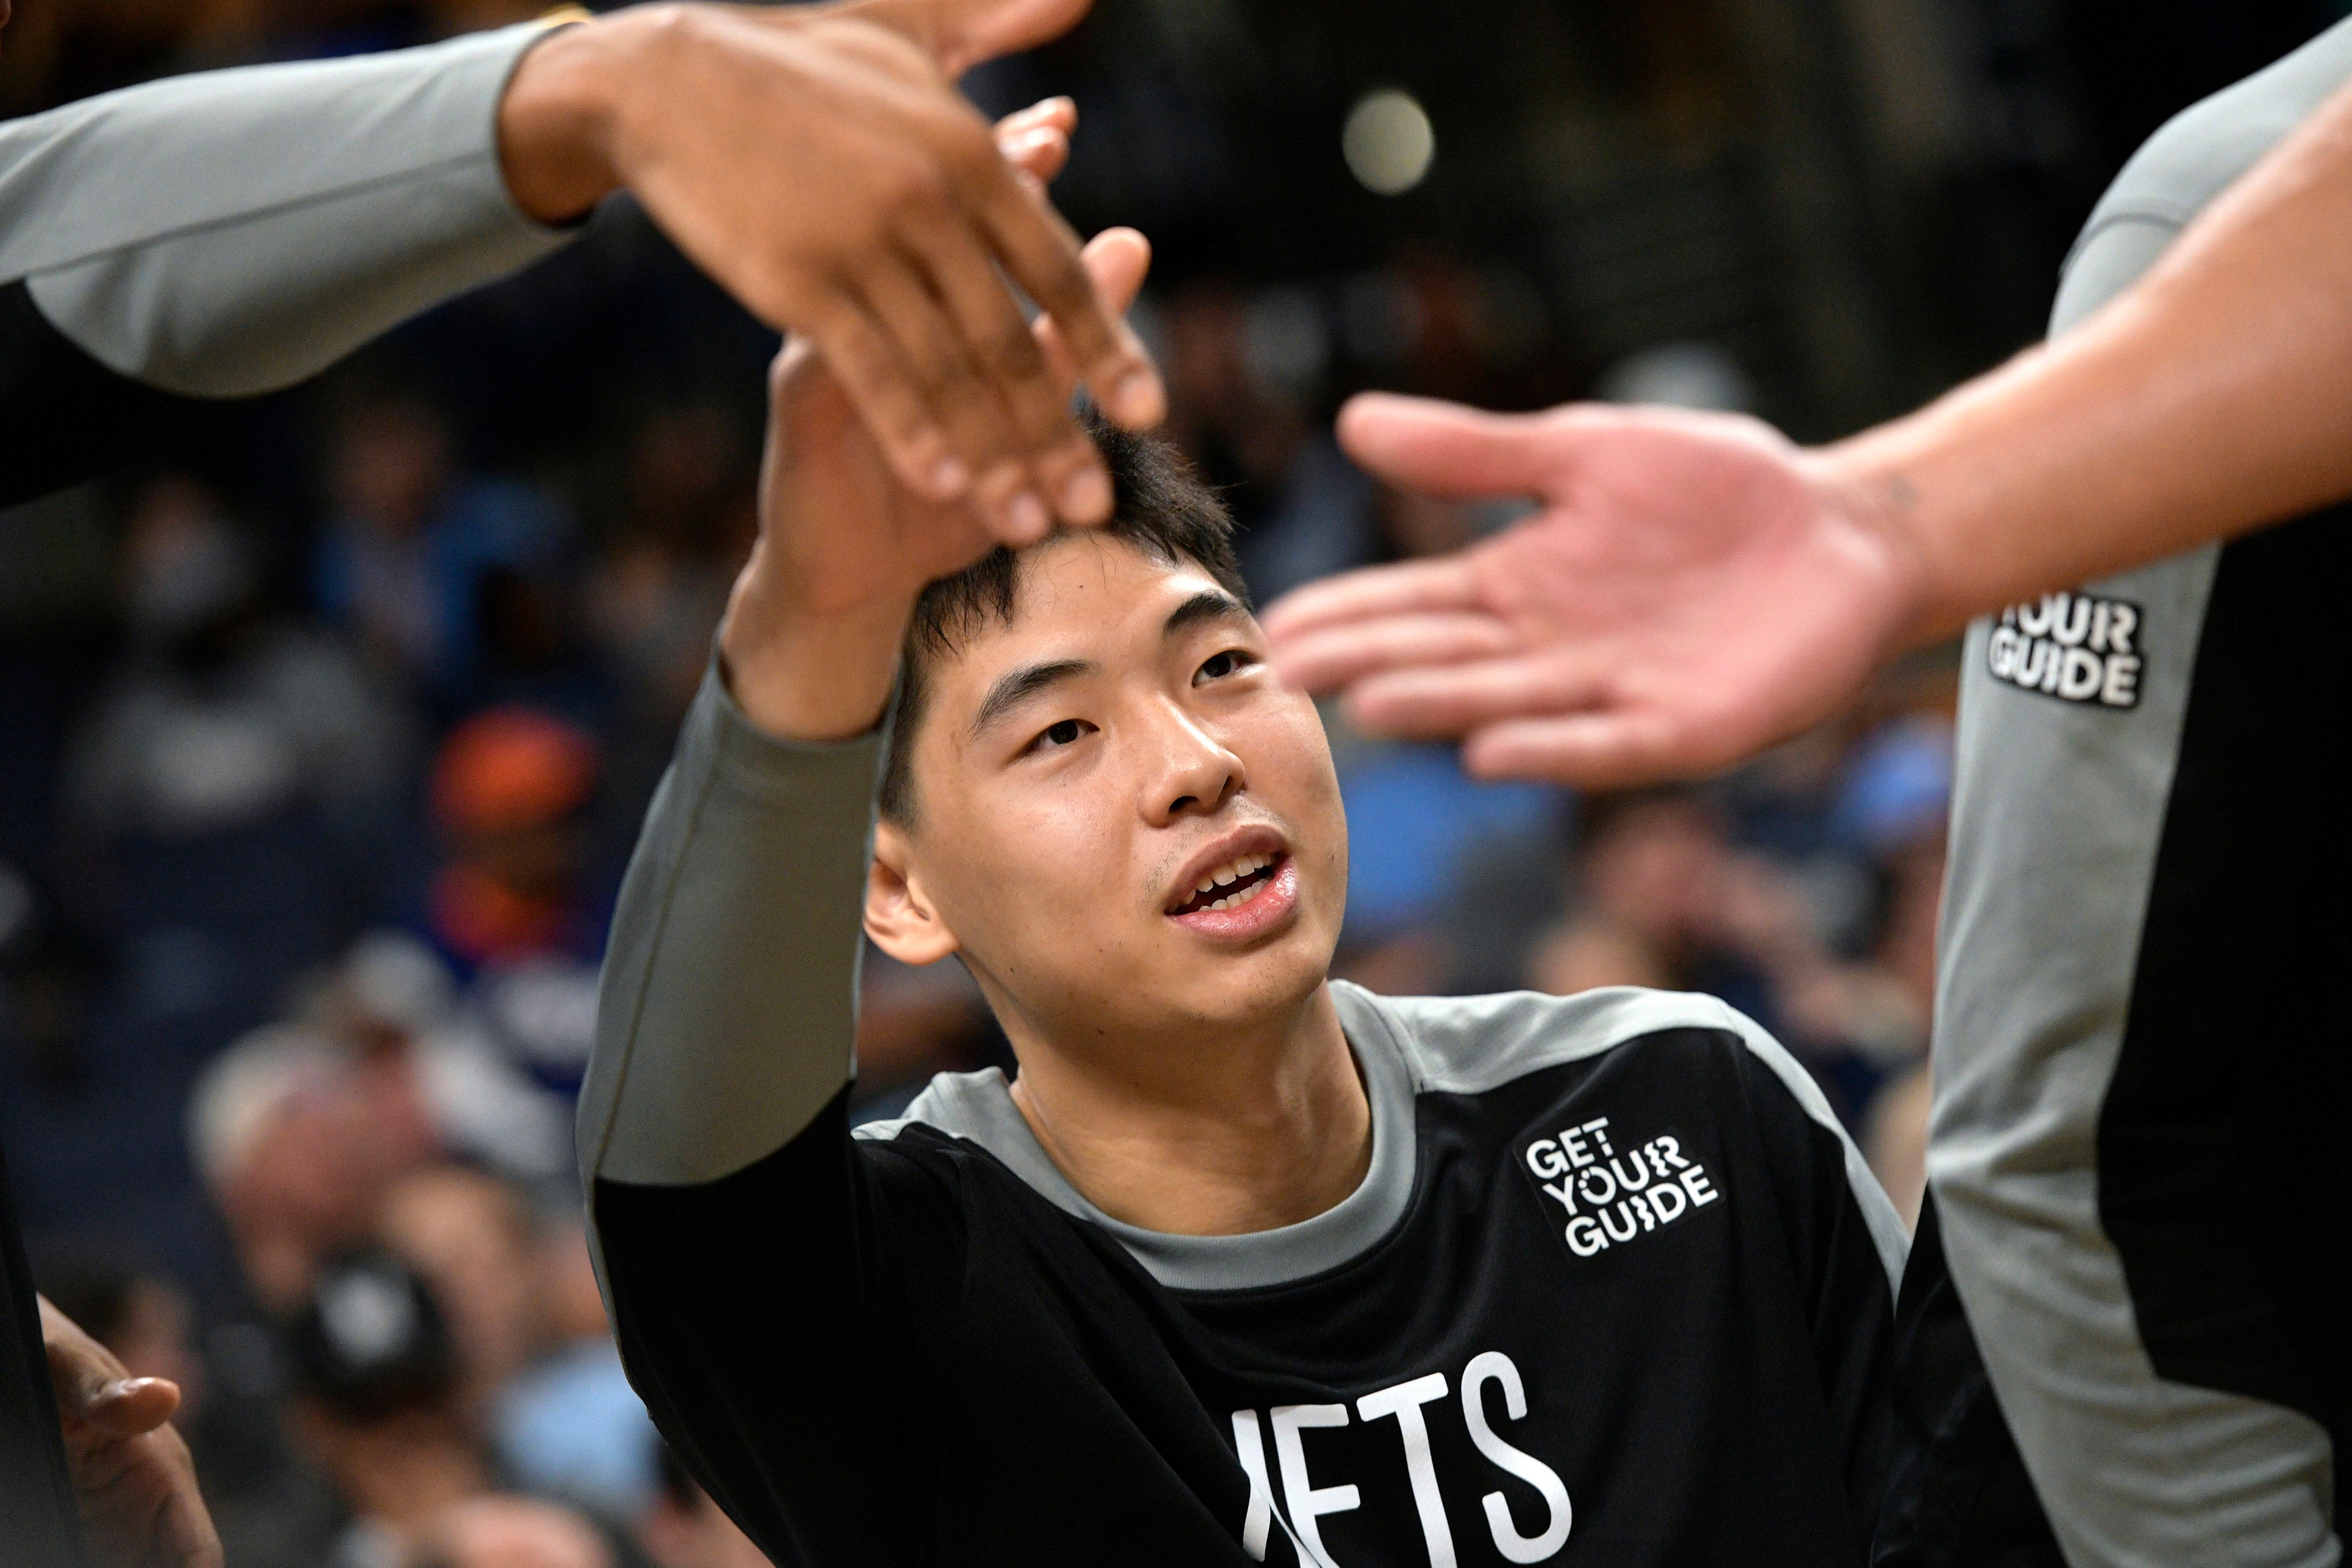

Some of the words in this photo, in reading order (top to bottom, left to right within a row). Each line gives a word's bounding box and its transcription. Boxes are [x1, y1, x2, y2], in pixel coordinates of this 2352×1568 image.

[1989, 626, 2142, 706] GUIDE
[1526, 1117, 1614, 1179] GET
[1542, 1136, 1690, 1216] YOUR
[1565, 1164, 1718, 1257] GUIDE
